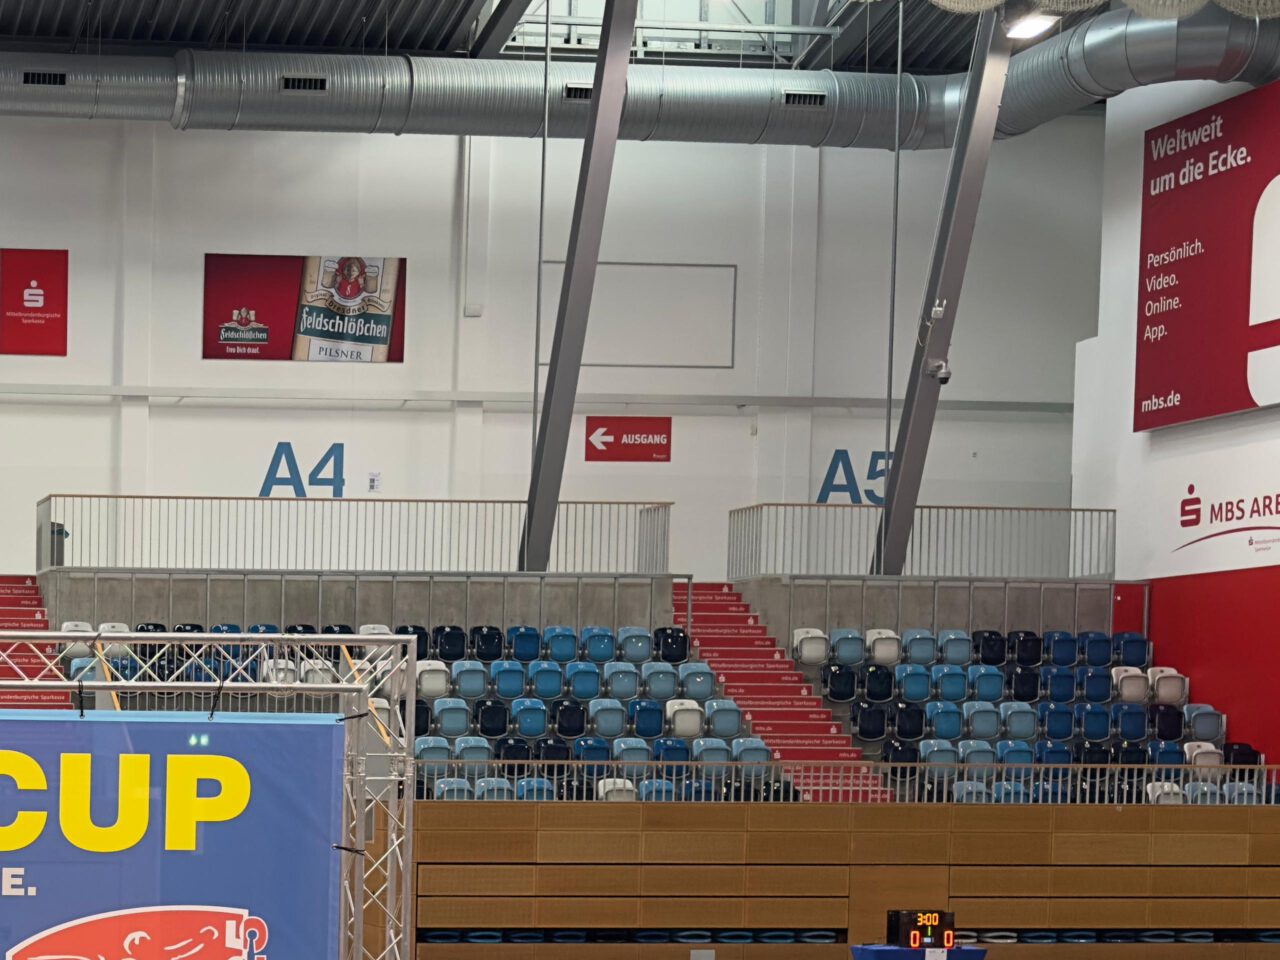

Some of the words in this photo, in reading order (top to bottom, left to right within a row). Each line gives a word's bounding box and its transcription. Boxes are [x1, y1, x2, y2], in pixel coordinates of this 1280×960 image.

[1151, 115, 1223, 161] Weltweit
[1150, 171, 1175, 196] um
[1179, 158, 1204, 185] die
[1208, 144, 1251, 176] Ecke.
[1147, 238, 1204, 269] Persönlich.
[1146, 273, 1179, 292] Video.
[328, 301, 365, 314] Dresdner
[1145, 296, 1182, 316] Online.
[1143, 324, 1168, 342] App.
[318, 346, 362, 360] PILSNER
[1141, 389, 1181, 413] mbs.de
[621, 434, 668, 444] AUSGANG
[258, 441, 345, 498] A4
[816, 449, 896, 507] A5
[1210, 498, 1245, 524] MBS
[917, 913, 939, 926] 3:00
[910, 930, 920, 948] 0
[944, 930, 953, 948] 0
